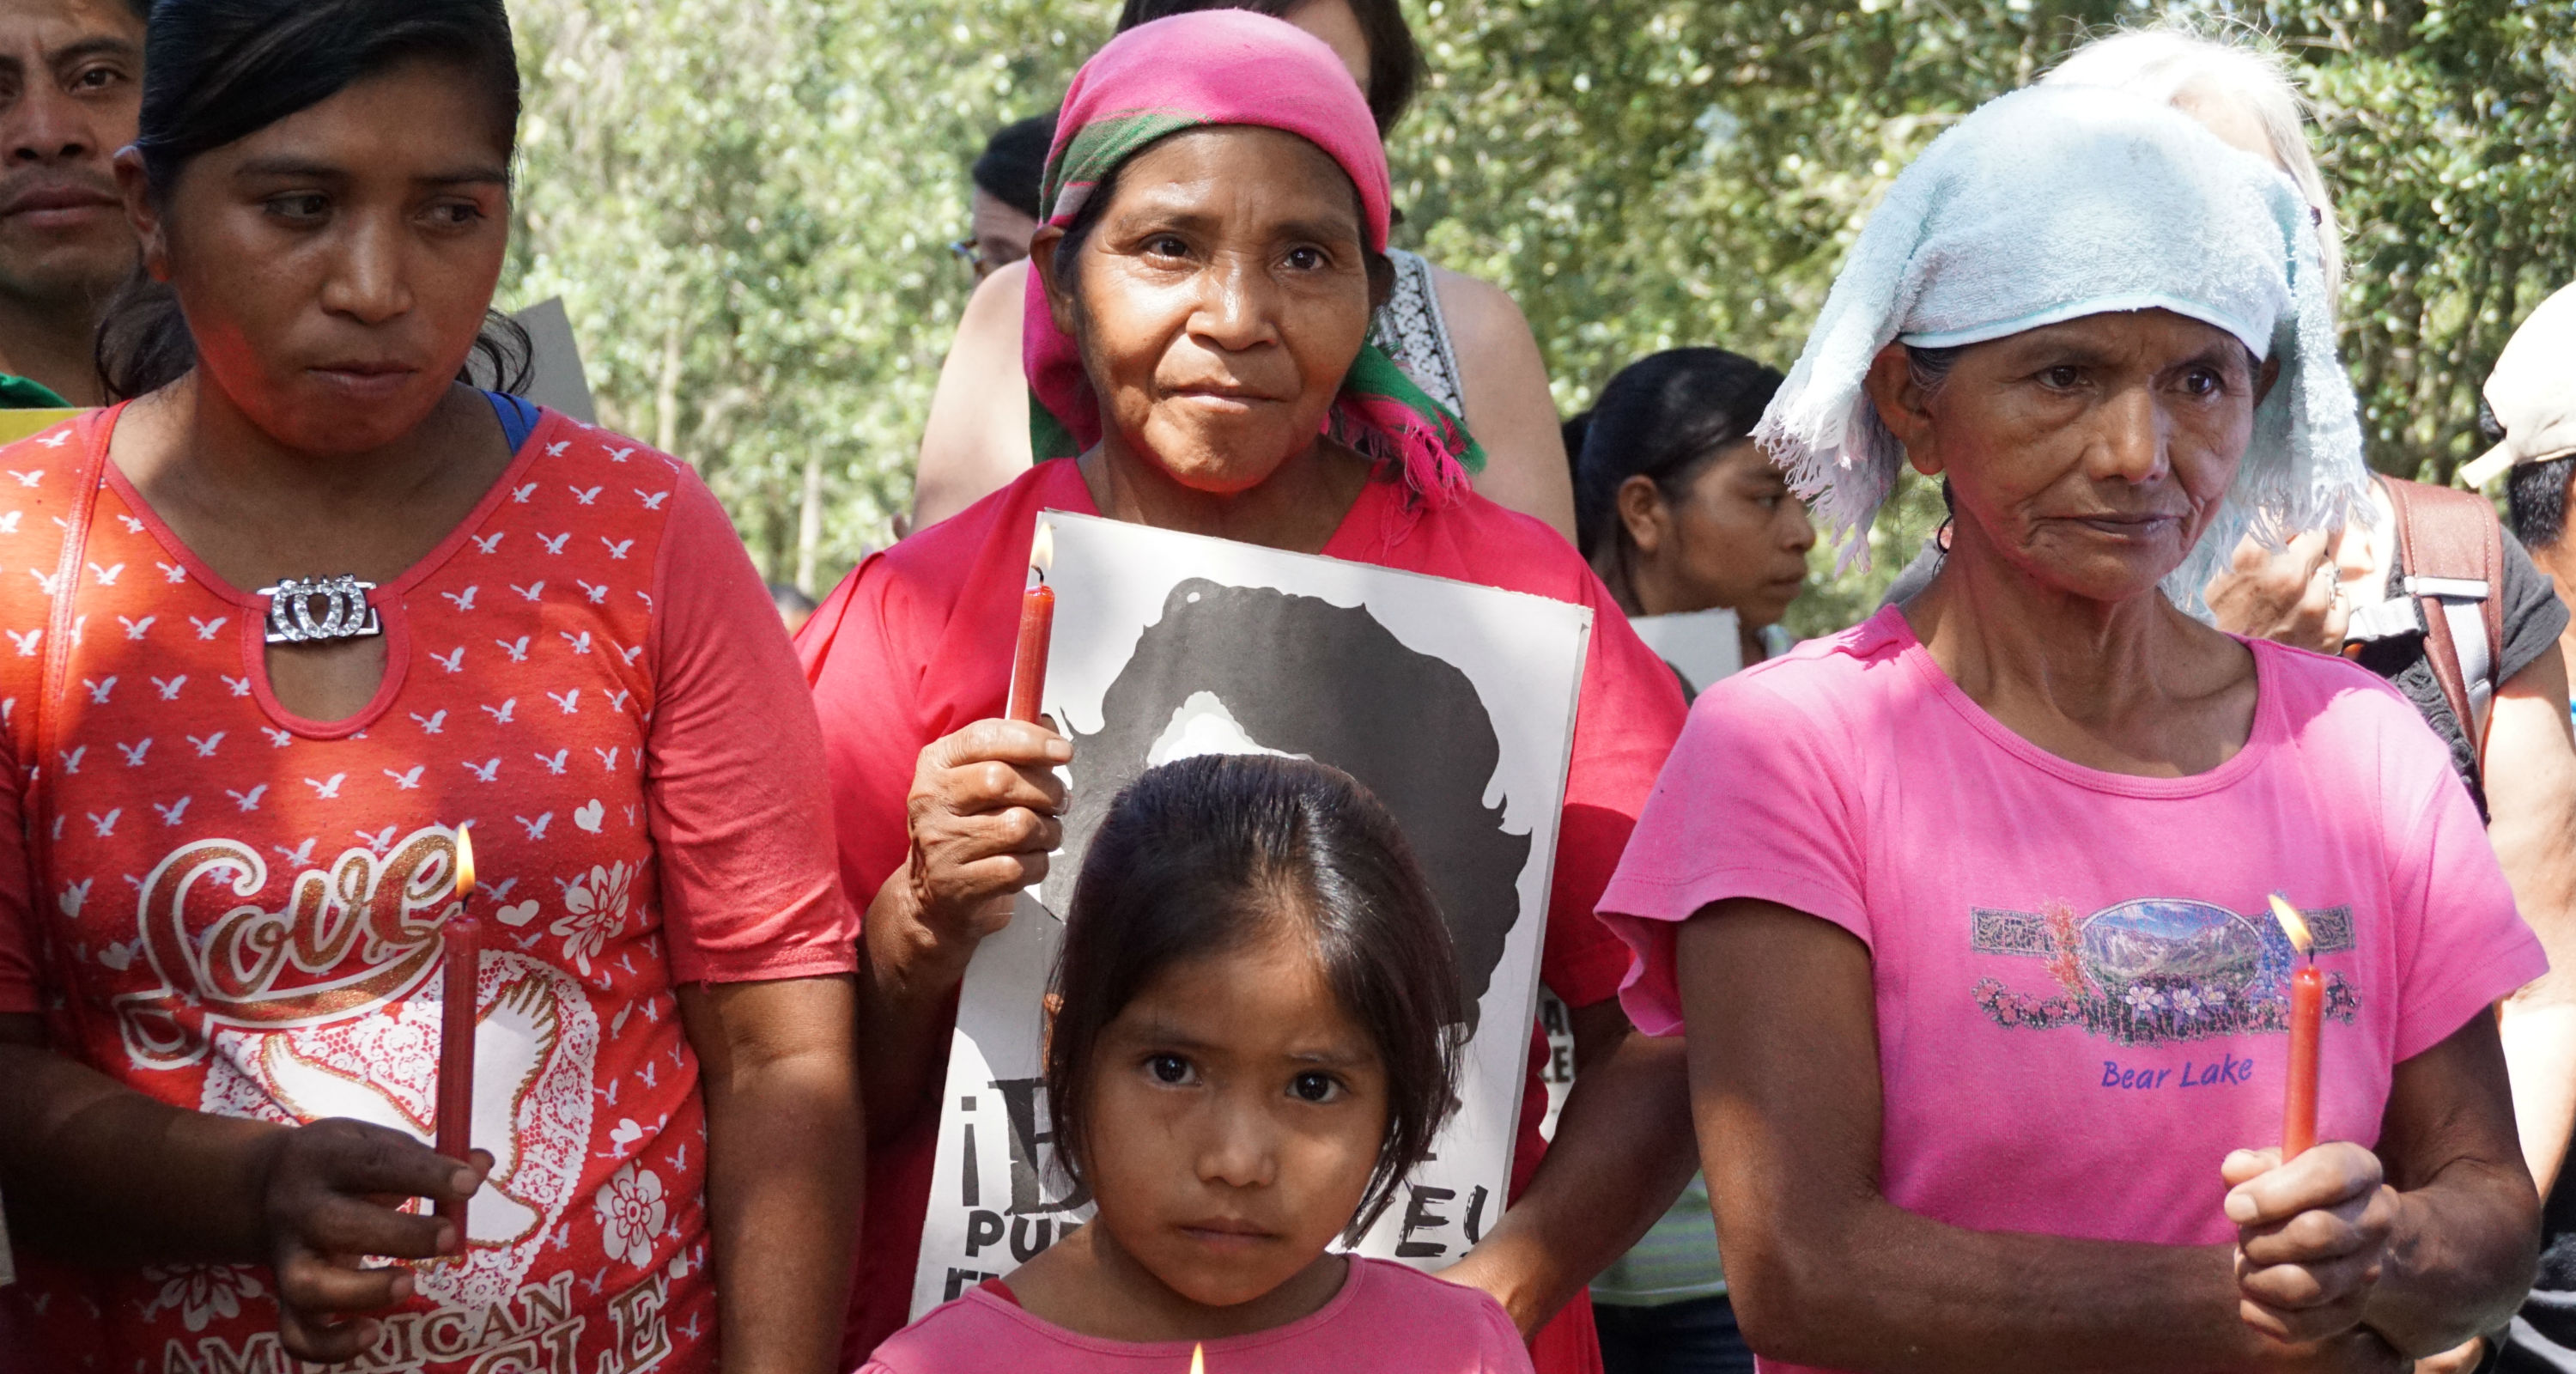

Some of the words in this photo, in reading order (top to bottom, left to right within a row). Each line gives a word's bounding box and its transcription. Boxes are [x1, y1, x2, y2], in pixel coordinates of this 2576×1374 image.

[112, 827, 465, 1070] Love
[2101, 1061, 2172, 1089] Bear
[2178, 1053, 2254, 1088] Lake
